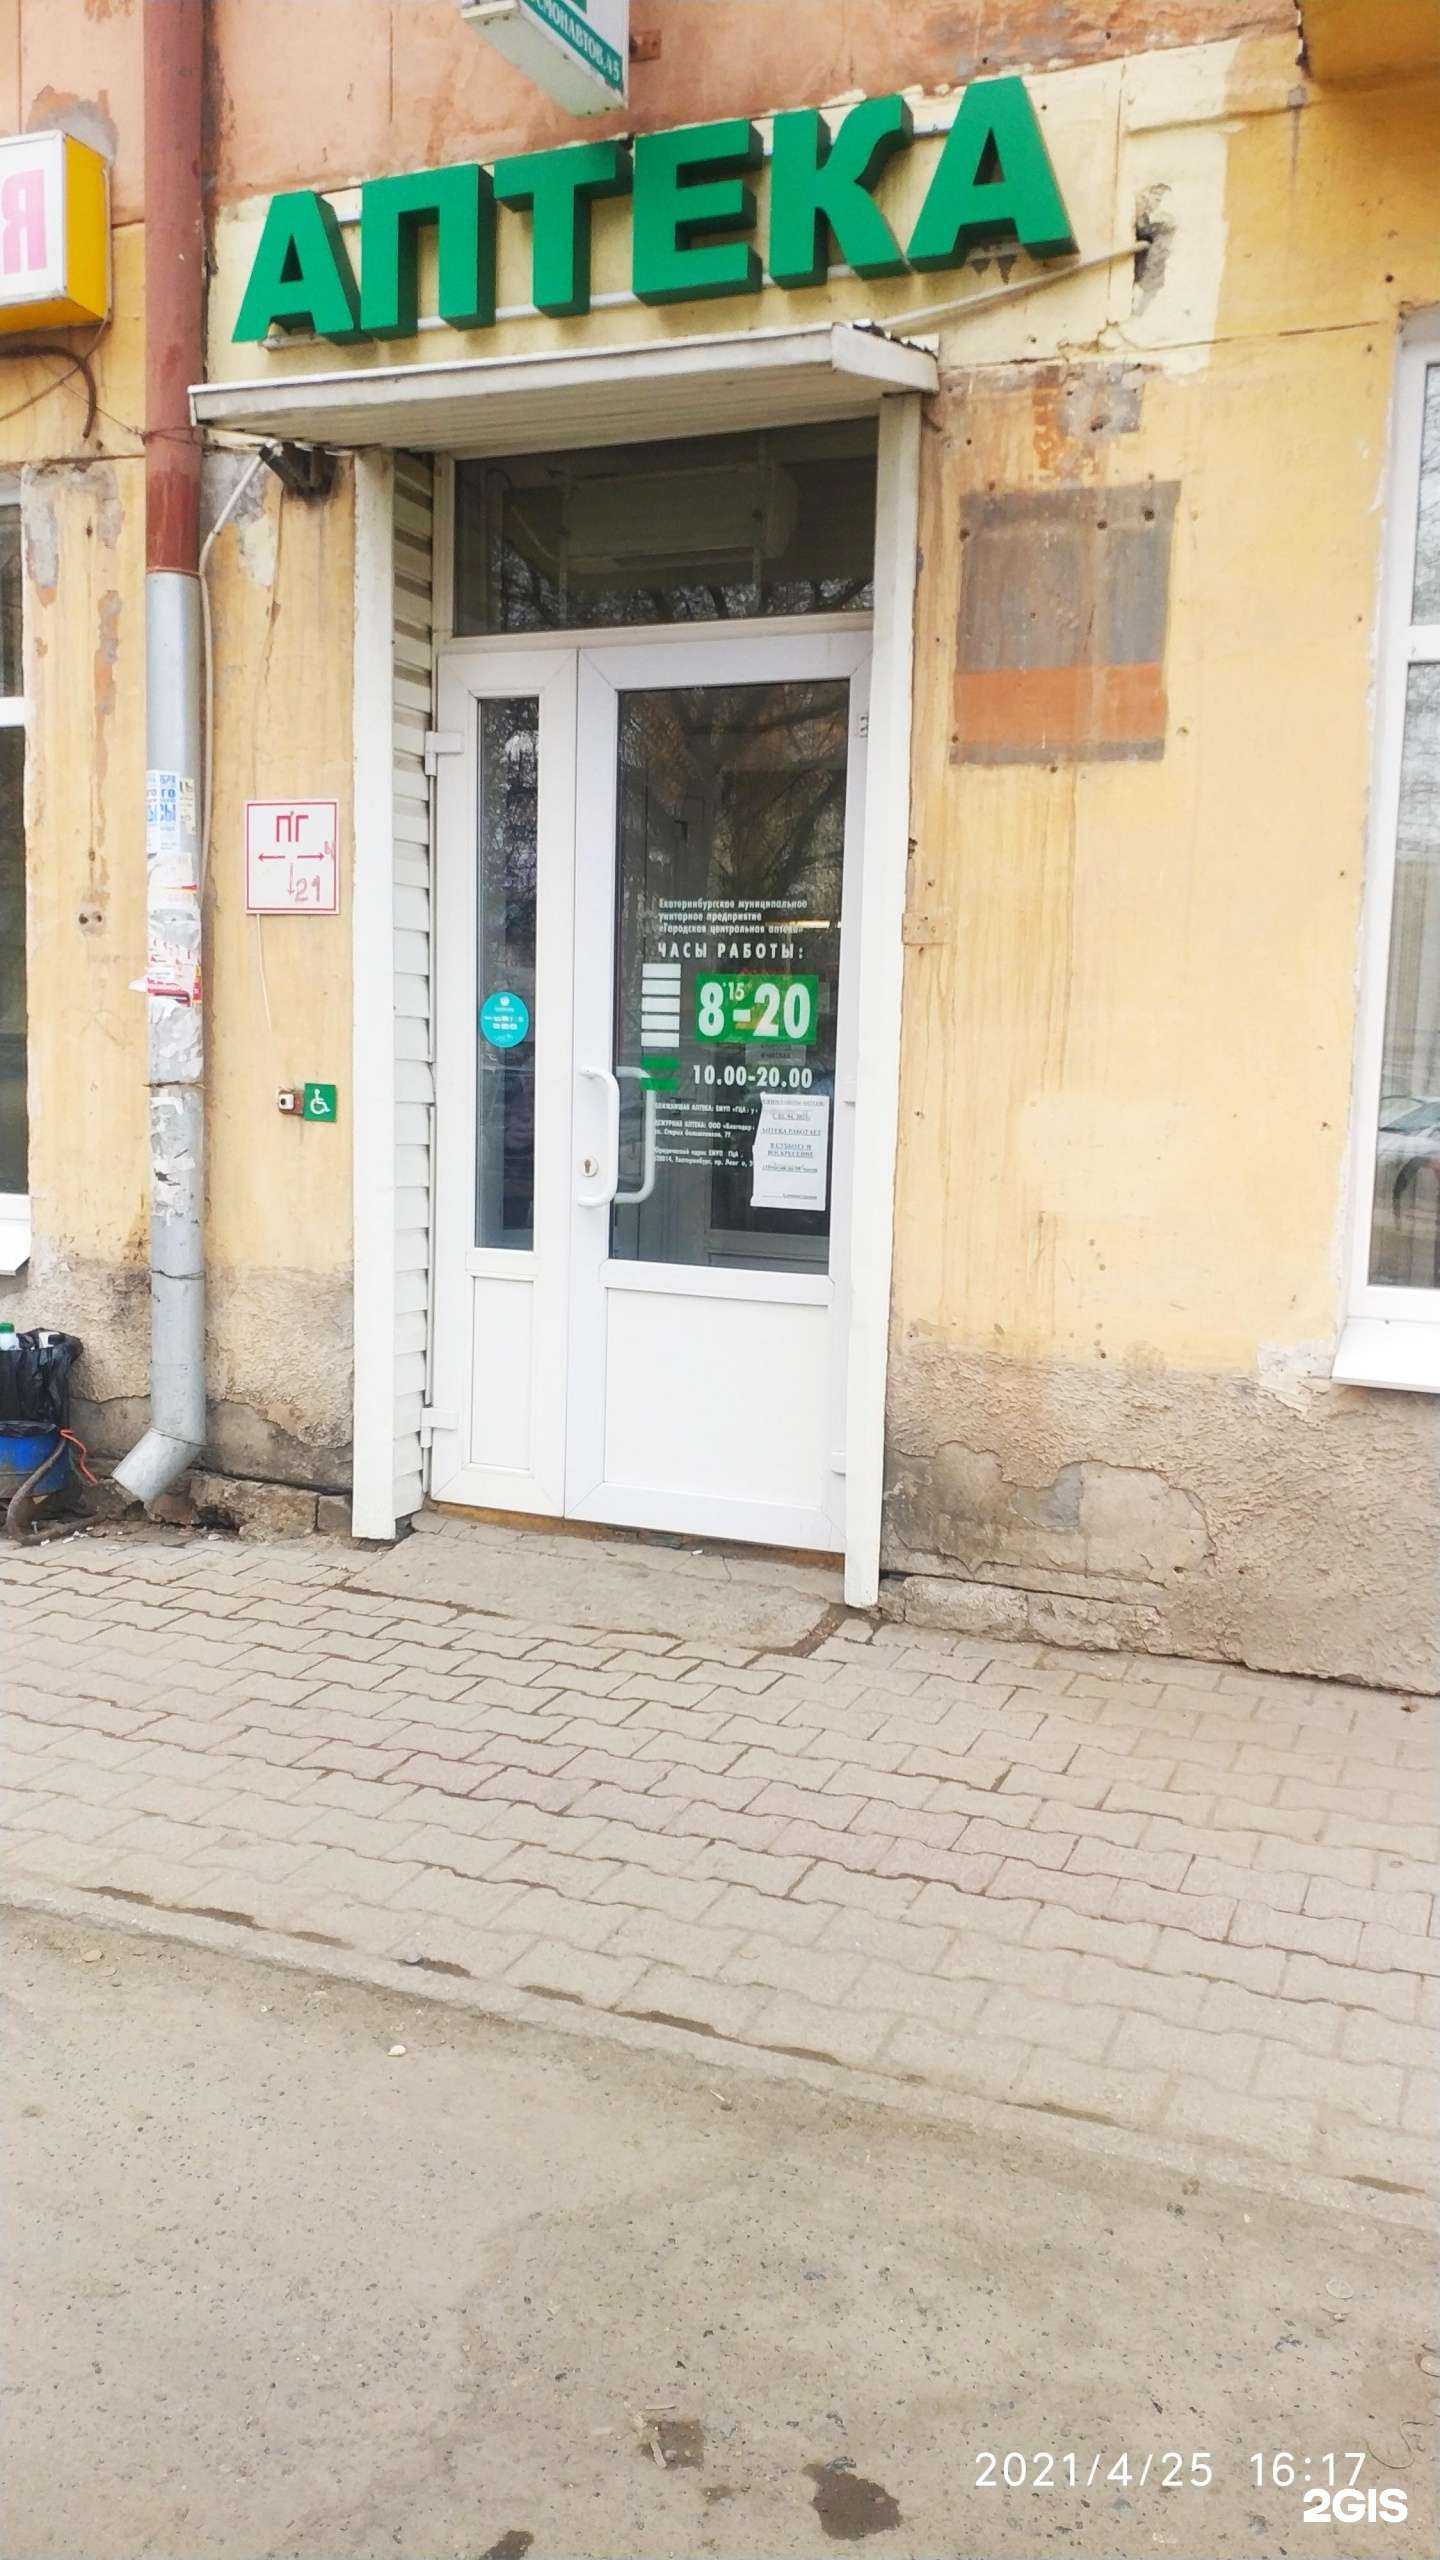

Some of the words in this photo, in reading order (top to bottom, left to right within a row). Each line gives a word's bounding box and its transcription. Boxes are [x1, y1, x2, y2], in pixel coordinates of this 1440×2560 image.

[232, 75, 1078, 343] АПТЕКА
[276, 814, 309, 842] ПГ
[295, 874, 321, 903] 21
[659, 898, 735, 911] Екатеринбургское
[738, 899, 808, 911] муниципальное
[658, 911, 704, 922] унитарное
[706, 912, 762, 923] предприятие
[710, 924, 765, 934] центральная
[657, 942, 707, 958] ЧАСЫ
[717, 942, 803, 959] РАБОТЫ:
[693, 1064, 813, 1089] 10.00-20.00
